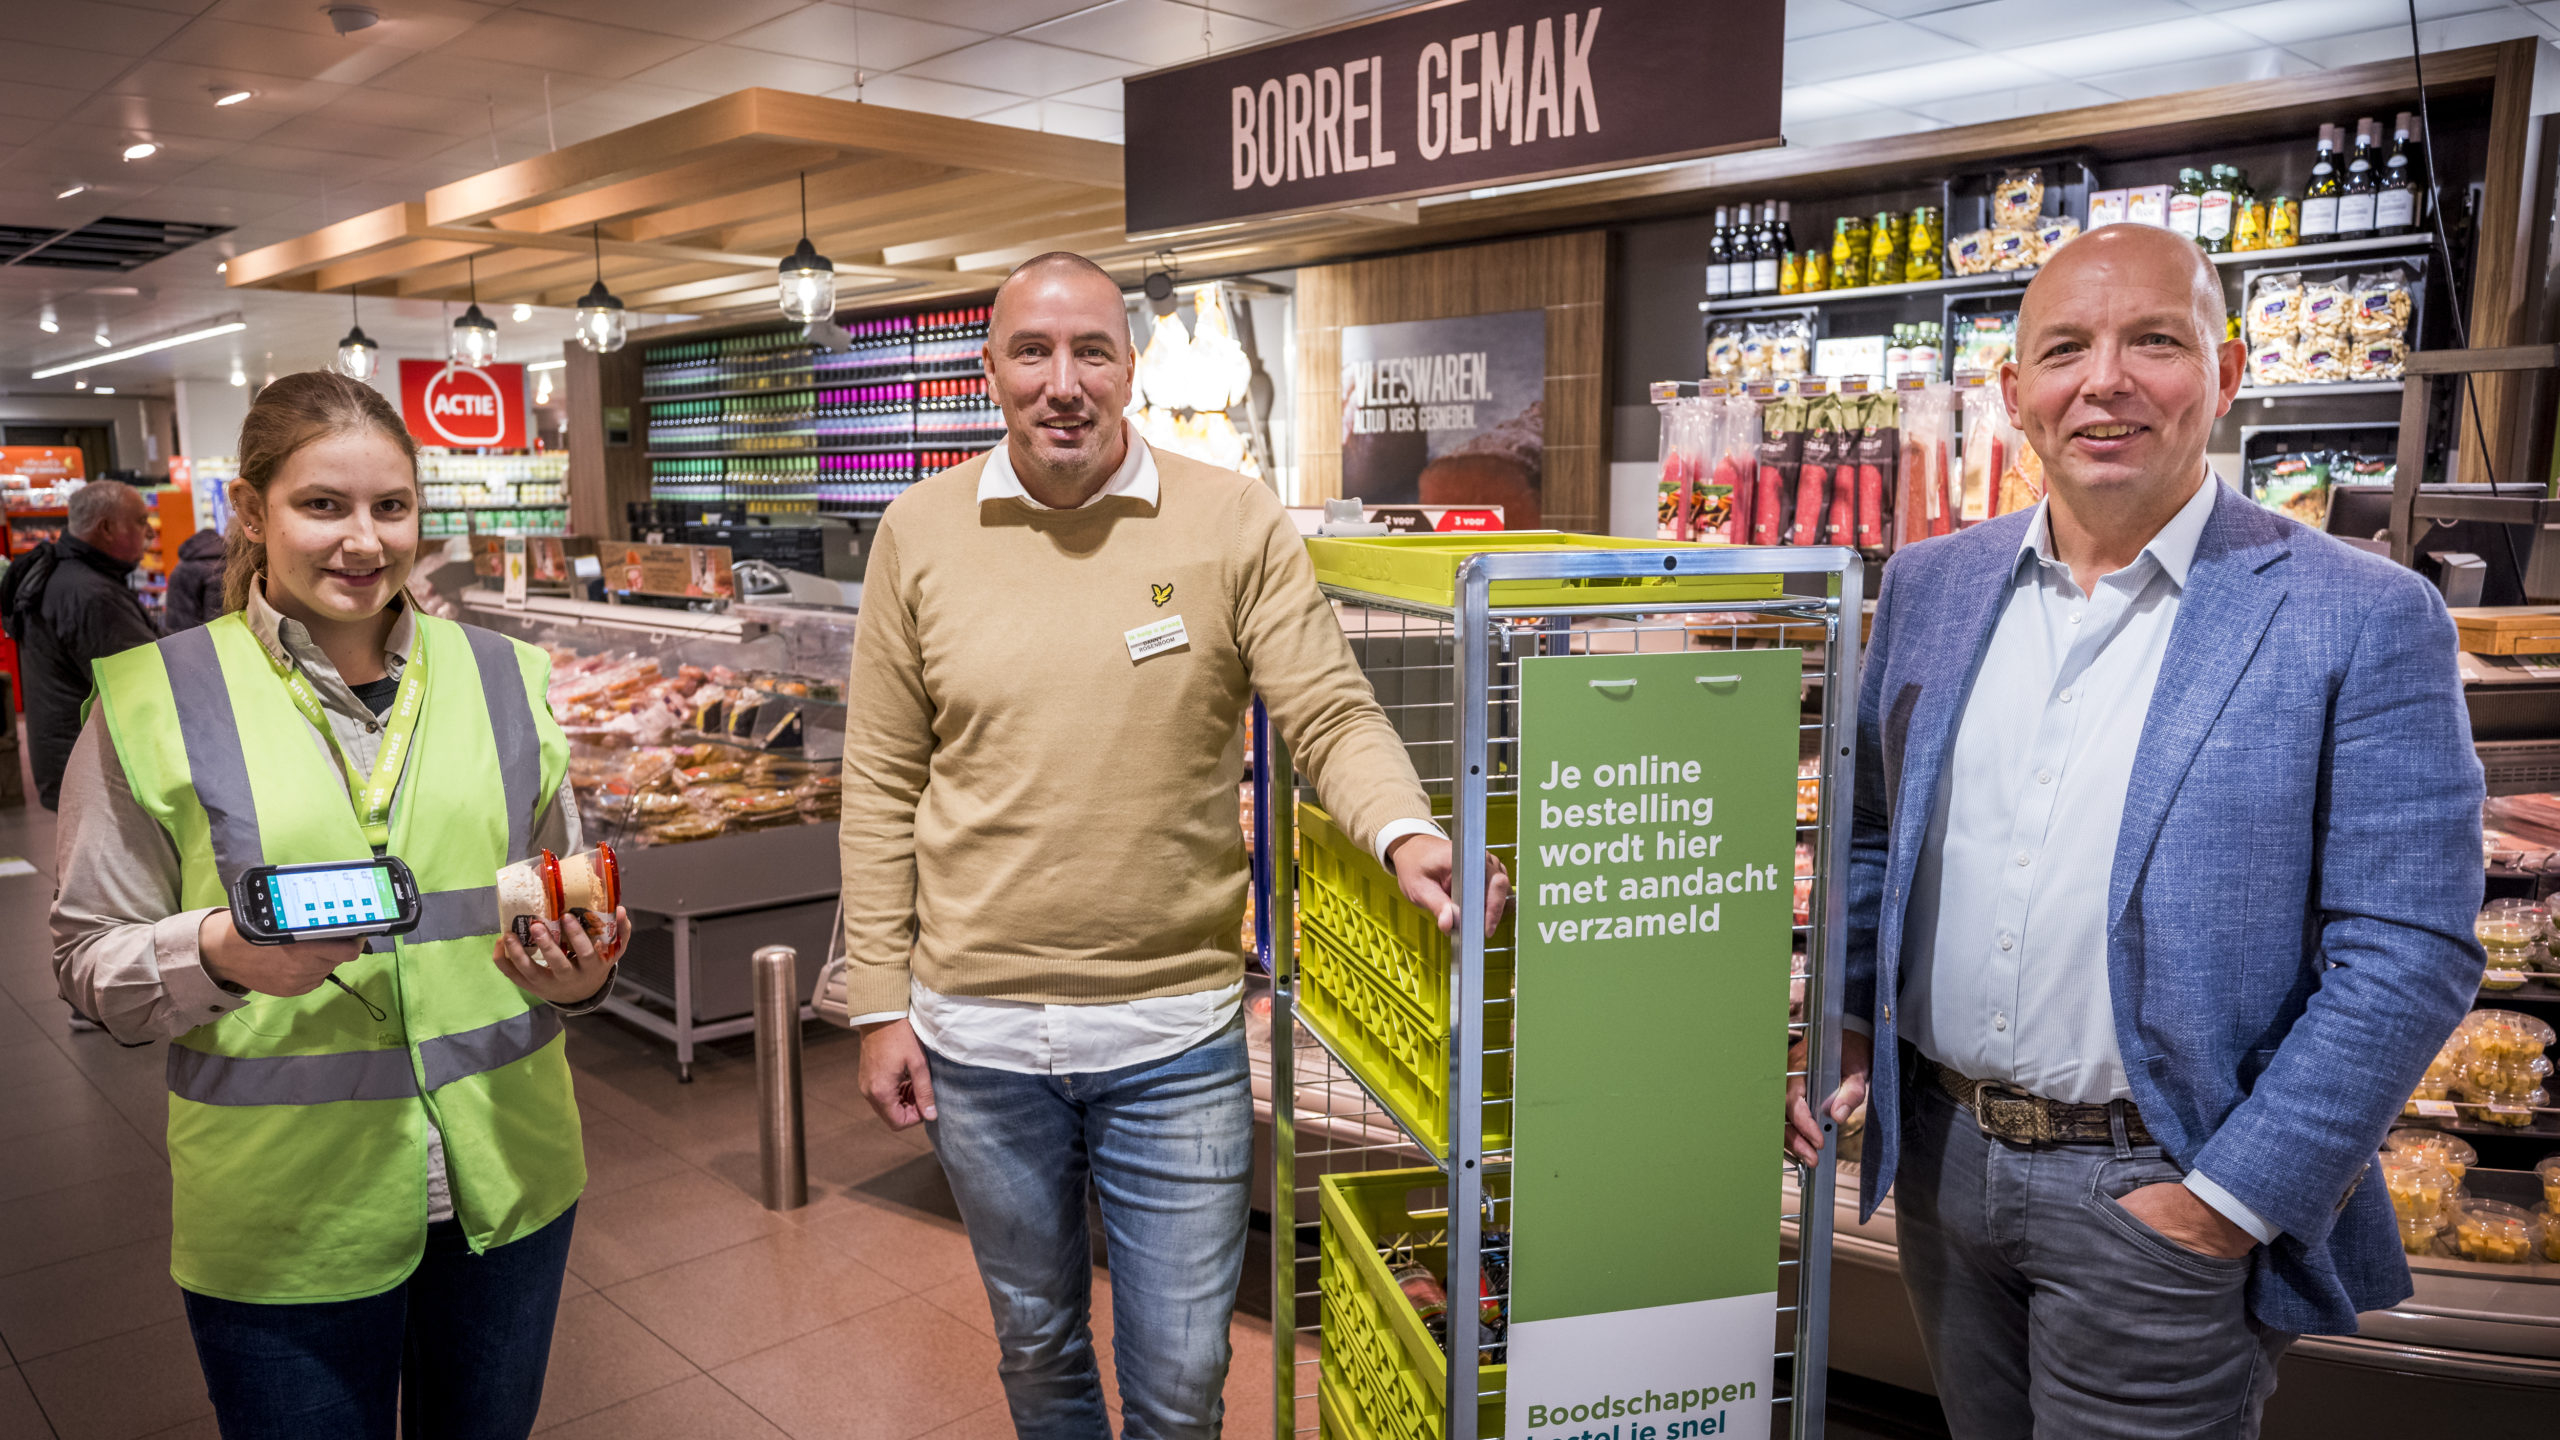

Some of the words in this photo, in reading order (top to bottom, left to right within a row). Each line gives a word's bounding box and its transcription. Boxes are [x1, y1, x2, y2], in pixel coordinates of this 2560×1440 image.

[1232, 56, 1395, 190] BORREL
[1417, 7, 1602, 161] GEMAK
[1353, 352, 1492, 406] VLEESWAREN.
[434, 393, 494, 416] ACTIE
[1390, 406, 1416, 432] VERS
[1384, 515, 1392, 525] 2
[1393, 517, 1416, 526] voor
[1454, 516, 1461, 526] 3
[1463, 518, 1486, 526] voor
[289, 678, 313, 708] PLUS
[400, 687, 416, 717] PLUS
[383, 741, 400, 772] PLUS
[1539, 761, 1581, 790] Je
[1593, 755, 1701, 787] online
[1541, 793, 1713, 829] bestelling
[1539, 833, 1644, 867] wordt
[1656, 830, 1722, 860] hier
[1539, 875, 1607, 906] met
[1619, 863, 1778, 901] aandacht
[1538, 903, 1720, 944] verzameld
[1528, 1381, 1756, 1428] Boodschappen
[1631, 1422, 1656, 1440] je
[1667, 1410, 1726, 1440] snel
